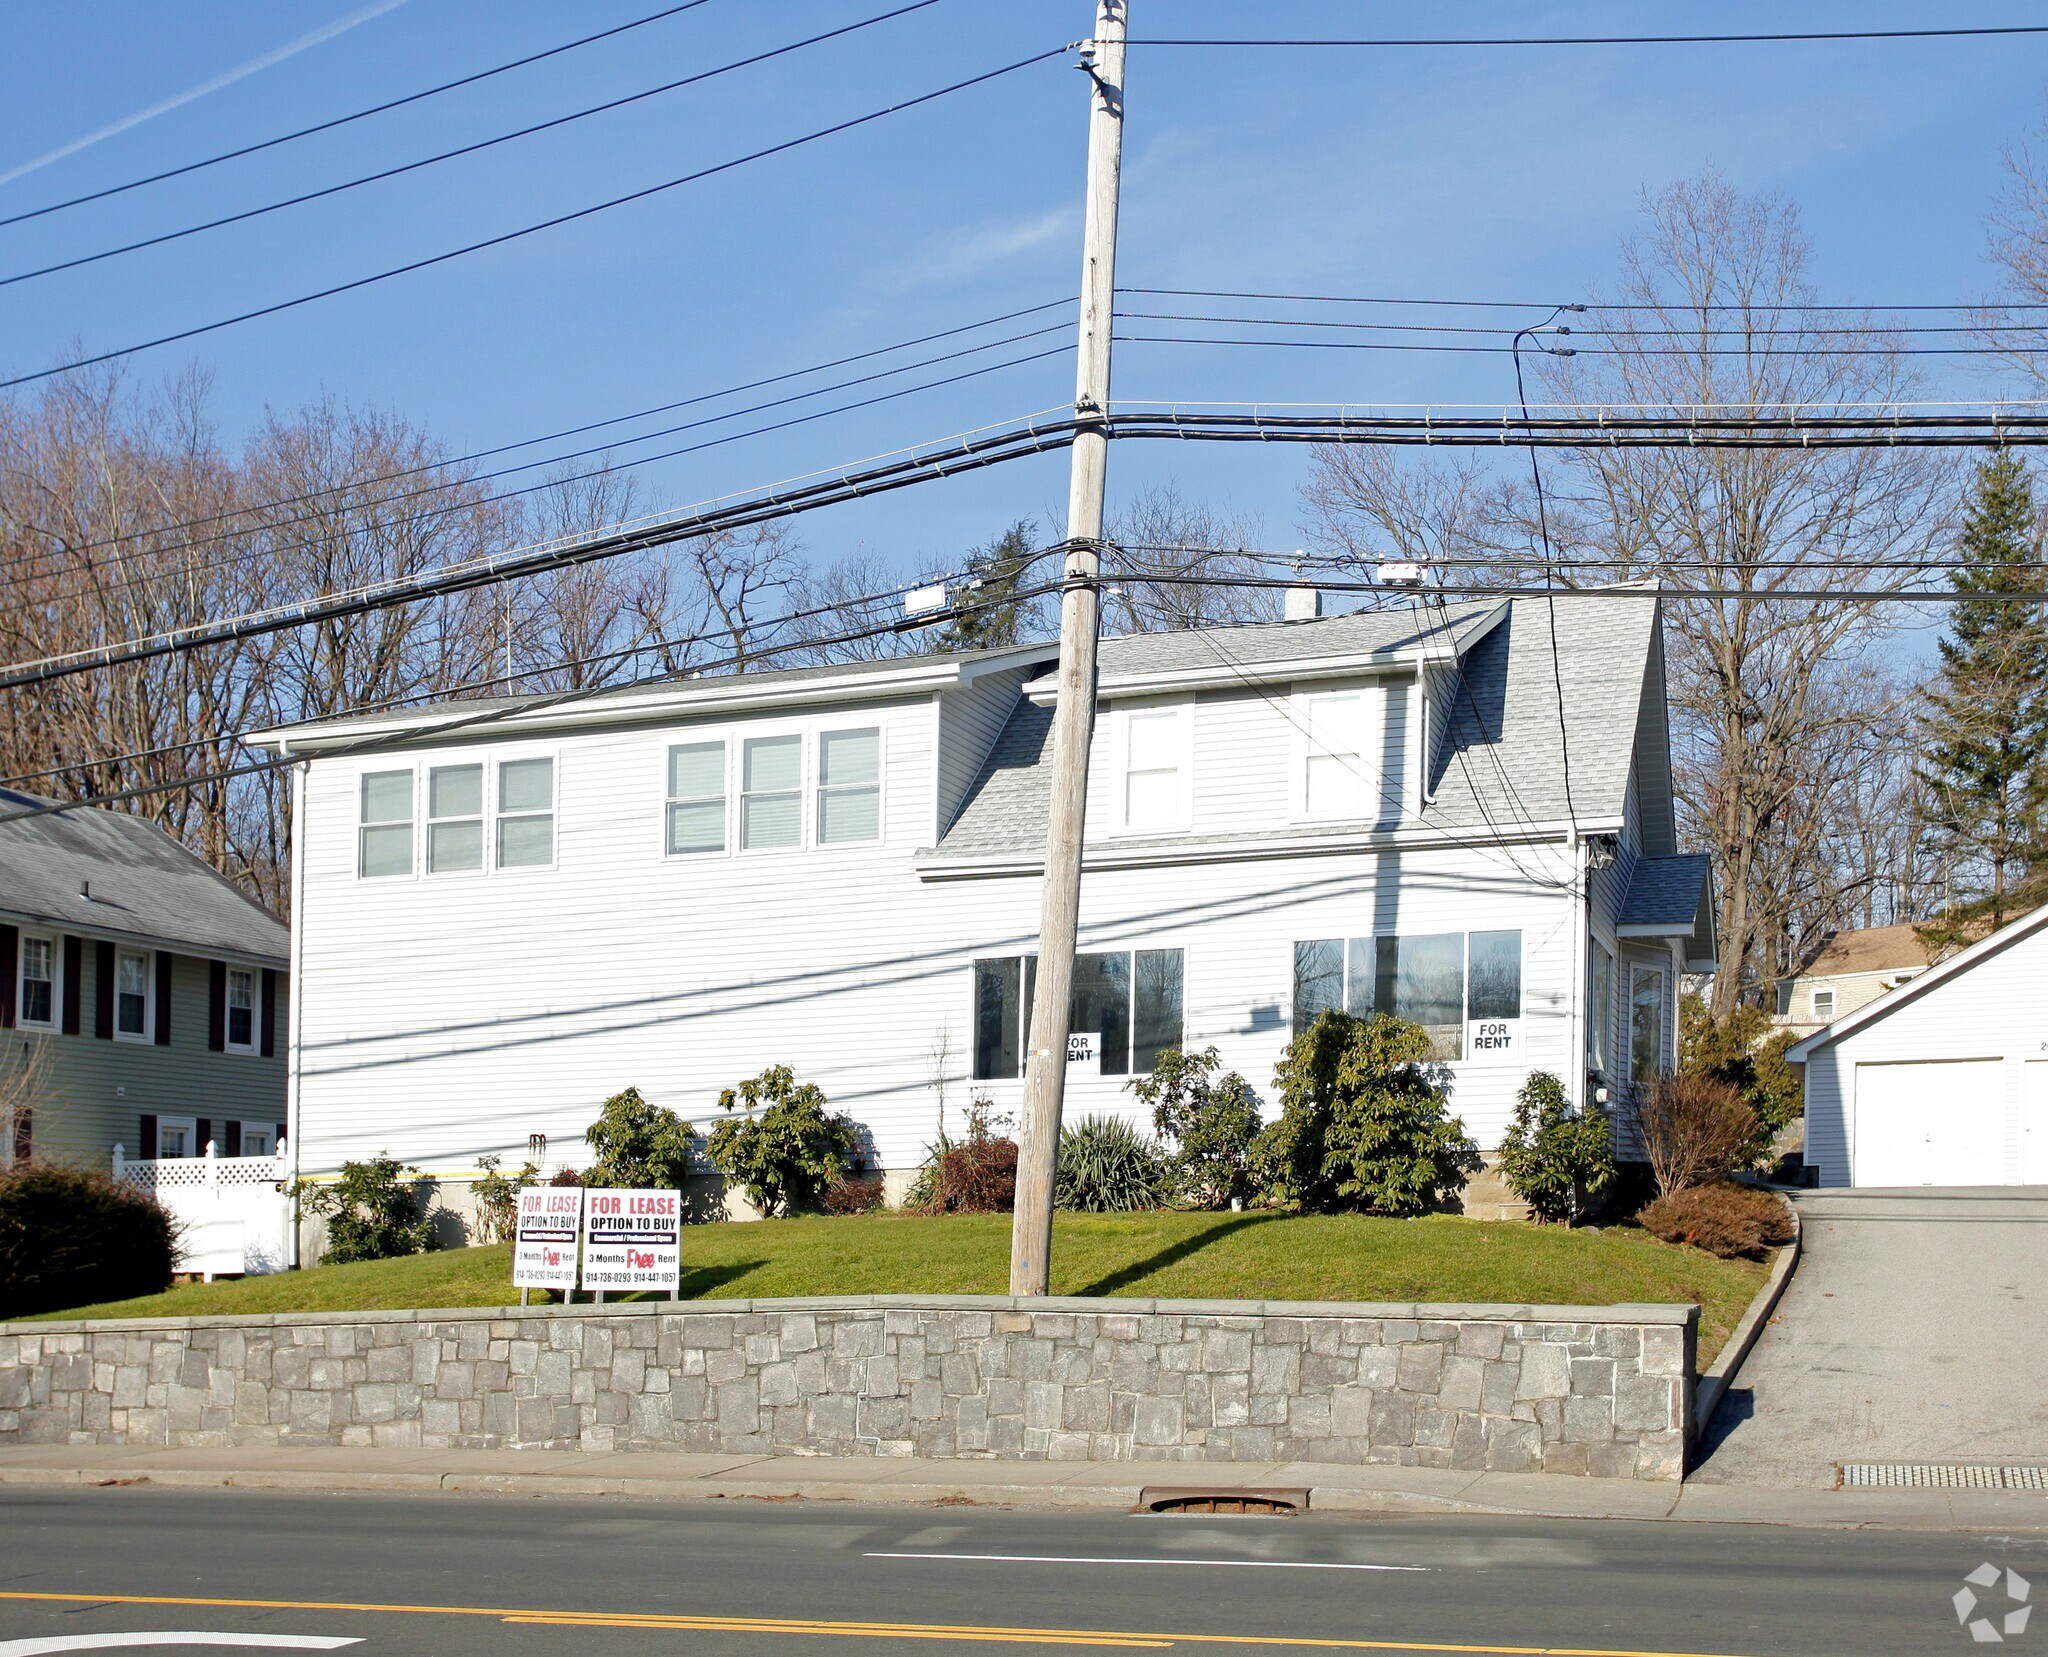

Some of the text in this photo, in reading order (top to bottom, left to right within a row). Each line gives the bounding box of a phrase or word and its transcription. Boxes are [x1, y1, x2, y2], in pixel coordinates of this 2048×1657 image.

[1480, 1024, 1507, 1035] FOR
[1475, 1036, 1511, 1049] RENT
[1067, 1050, 1092, 1061] ENT
[522, 1196, 577, 1212] FOR LEASE
[591, 1197, 675, 1214] FOR LEASE
[521, 1216, 576, 1228] OPTION TO BUY
[591, 1217, 676, 1230] OPTION TO BUY
[523, 1252, 541, 1260] Months
[543, 1247, 560, 1266] Free
[562, 1253, 574, 1261] Rent
[589, 1254, 594, 1262] 3
[596, 1254, 625, 1262] Months
[627, 1249, 655, 1268] Free
[585, 1272, 676, 1282] 914-736-0293 914-447-1057
